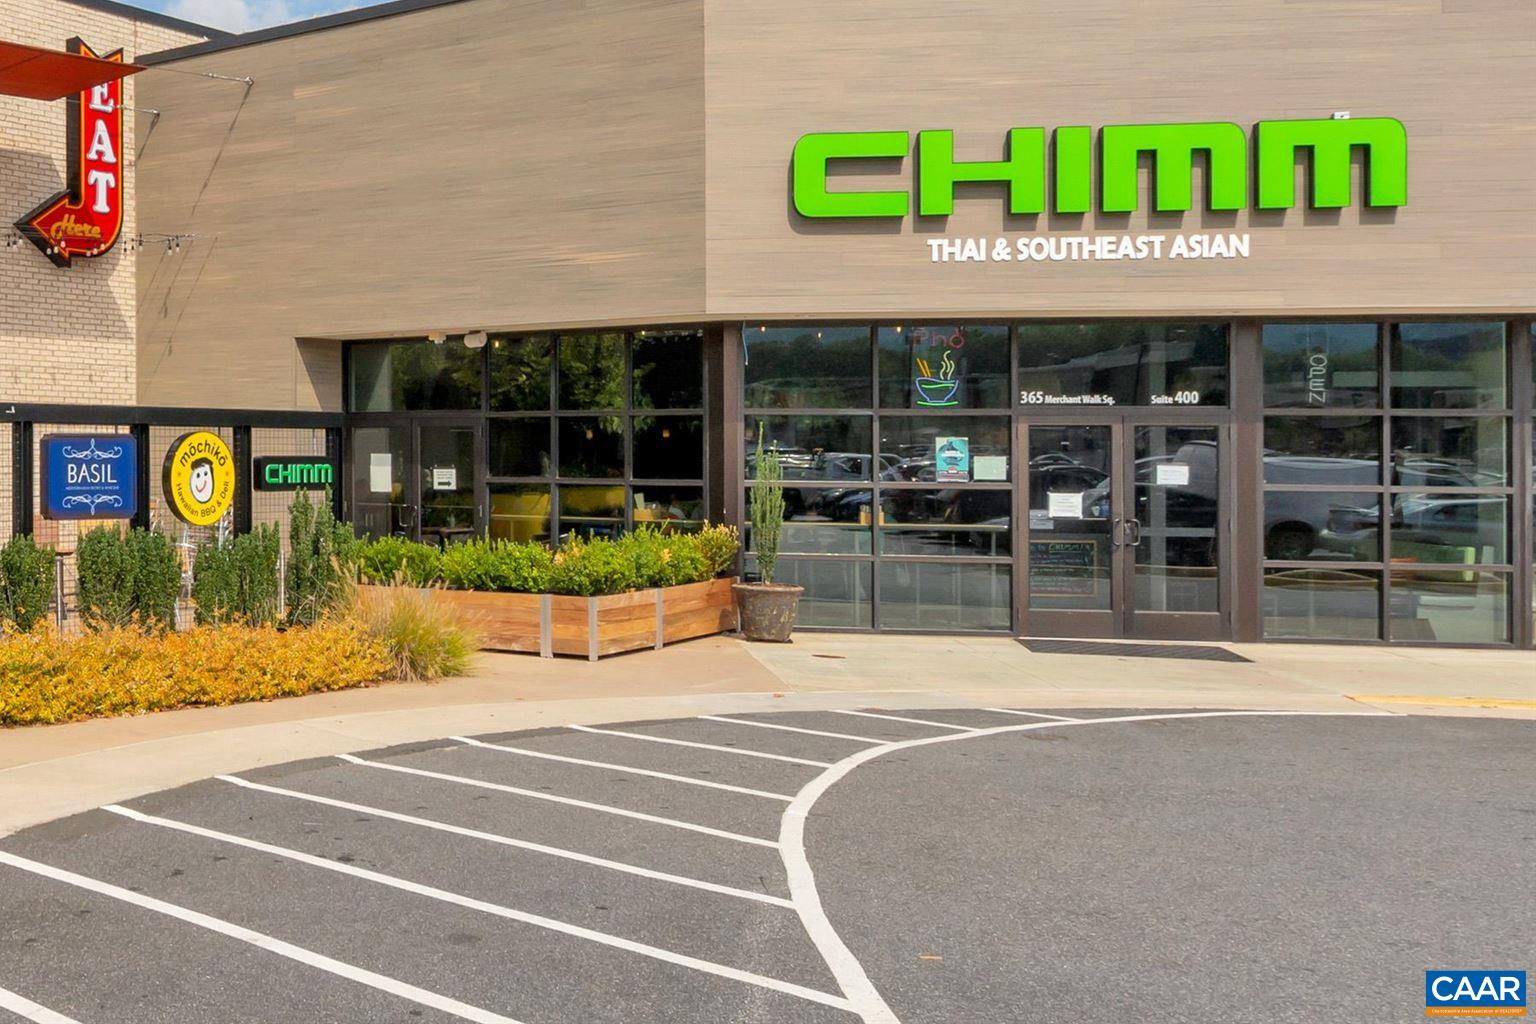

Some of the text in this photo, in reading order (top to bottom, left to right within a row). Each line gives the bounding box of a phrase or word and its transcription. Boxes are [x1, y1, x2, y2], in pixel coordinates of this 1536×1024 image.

[792, 116, 1407, 218] CHIMM
[927, 233, 1250, 262] THAI & SOUTHEAST ASIAN
[1308, 354, 1328, 404] OPEN
[1020, 391, 1044, 404] 365
[1044, 394, 1081, 404] Merchant
[1081, 394, 1102, 404] Walk
[1151, 391, 1199, 404] Suite 400
[67, 463, 118, 484] BASIL
[265, 463, 333, 484] CHIMM
[176, 480, 230, 517] Hawaiian BBQ & Deli
